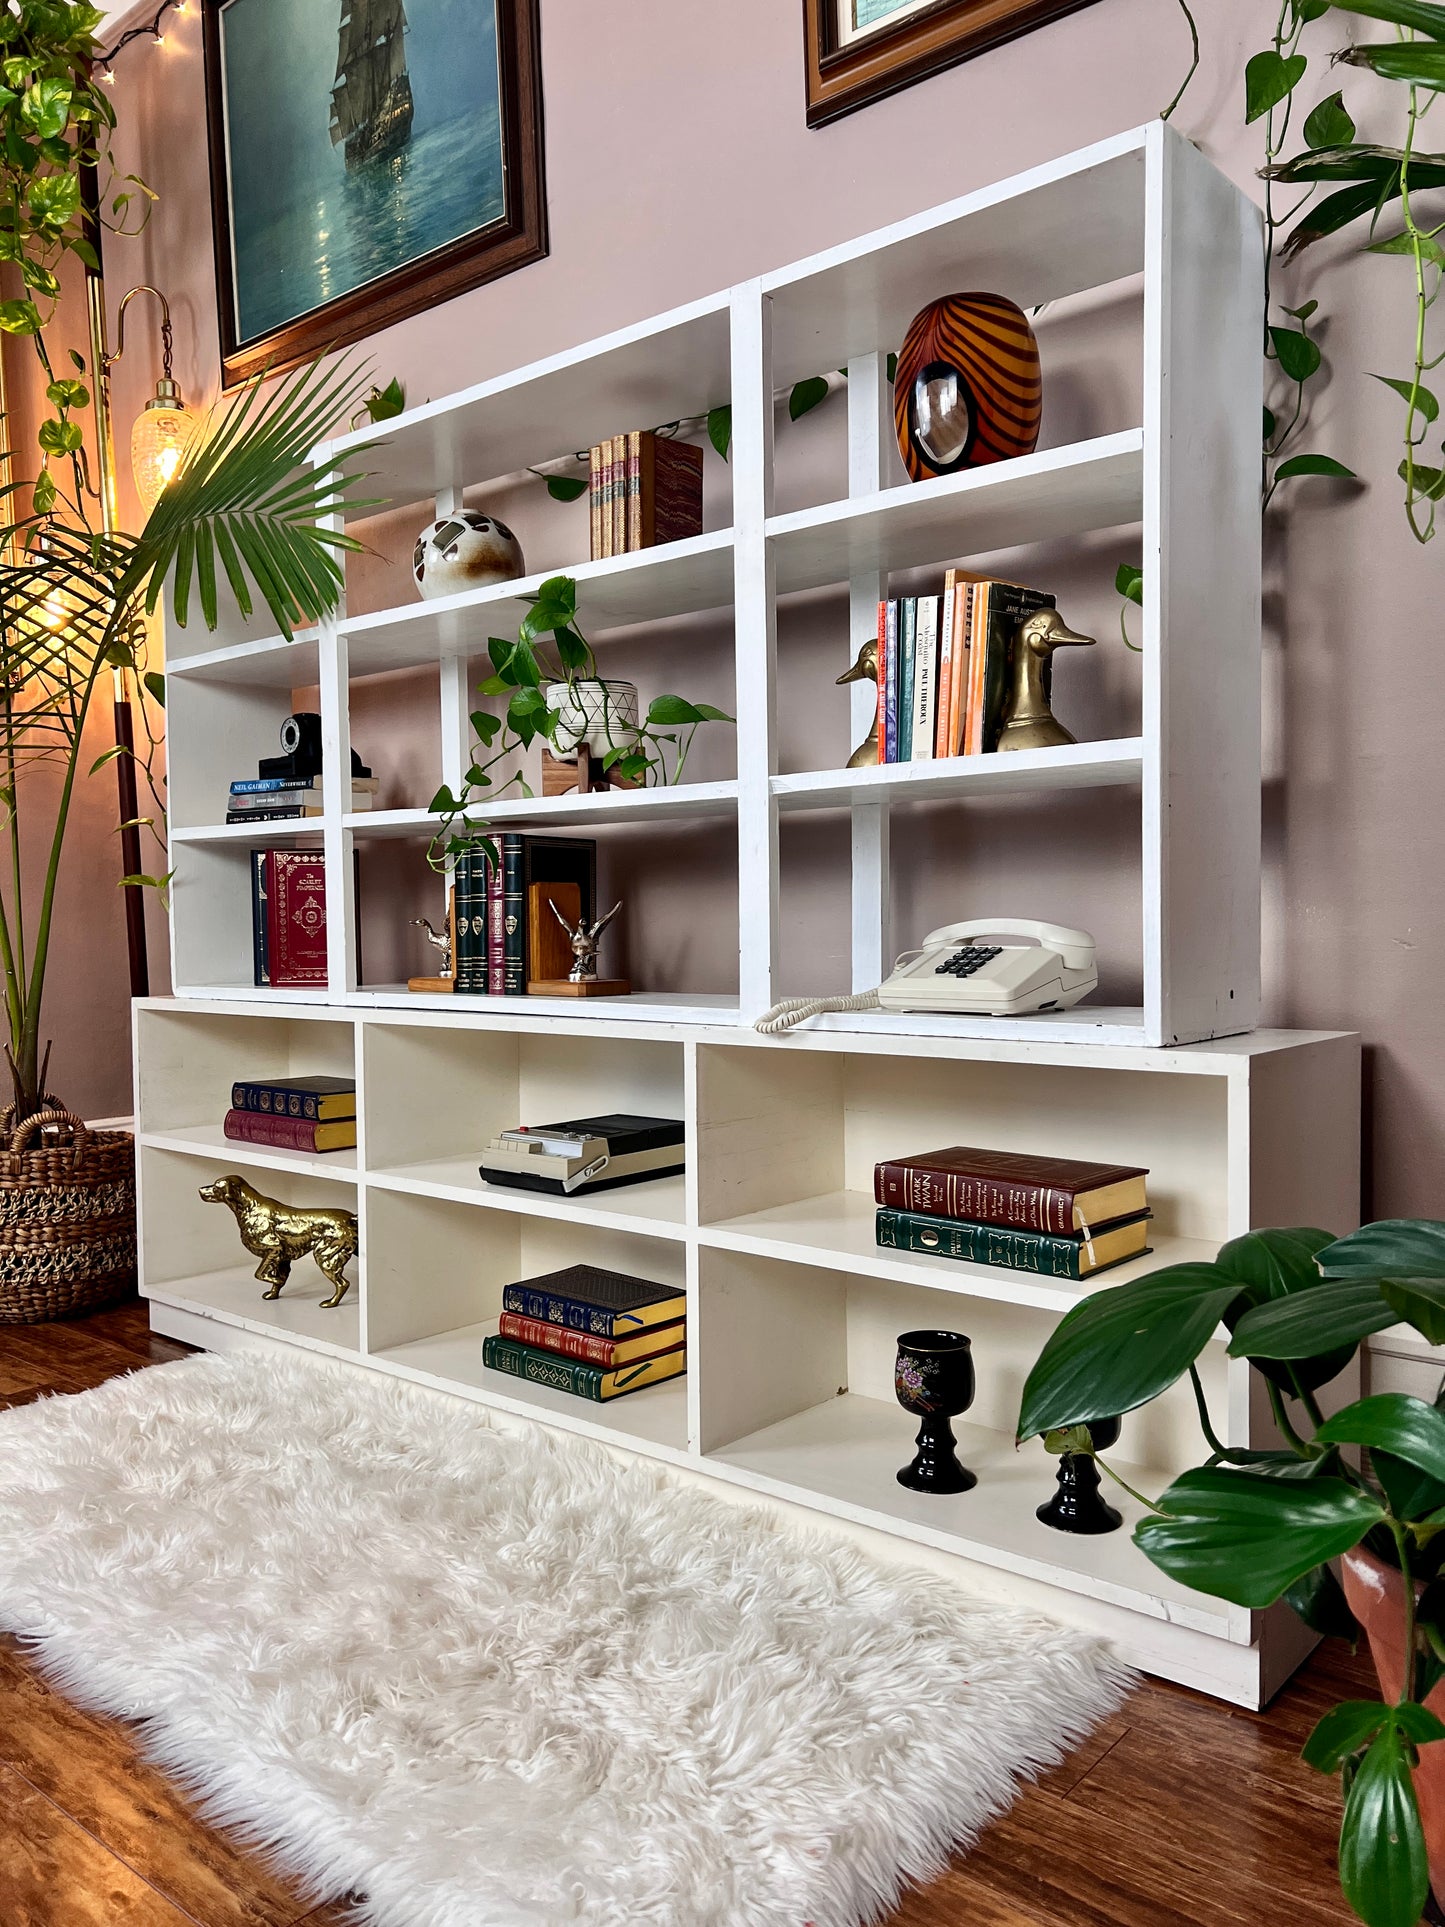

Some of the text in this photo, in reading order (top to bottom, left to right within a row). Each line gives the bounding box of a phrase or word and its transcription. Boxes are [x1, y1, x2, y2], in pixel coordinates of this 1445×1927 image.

[1006, 604, 1019, 614] JANE
[921, 625, 931, 665] Mosquito
[919, 668, 929, 725] PAUL THEROUX
[247, 782, 270, 790] GAIMAN
[913, 1177, 922, 1205] MARK
[921, 1174, 932, 1209] TWAIN
[1057, 1197, 1065, 1229] GRAMERCY
